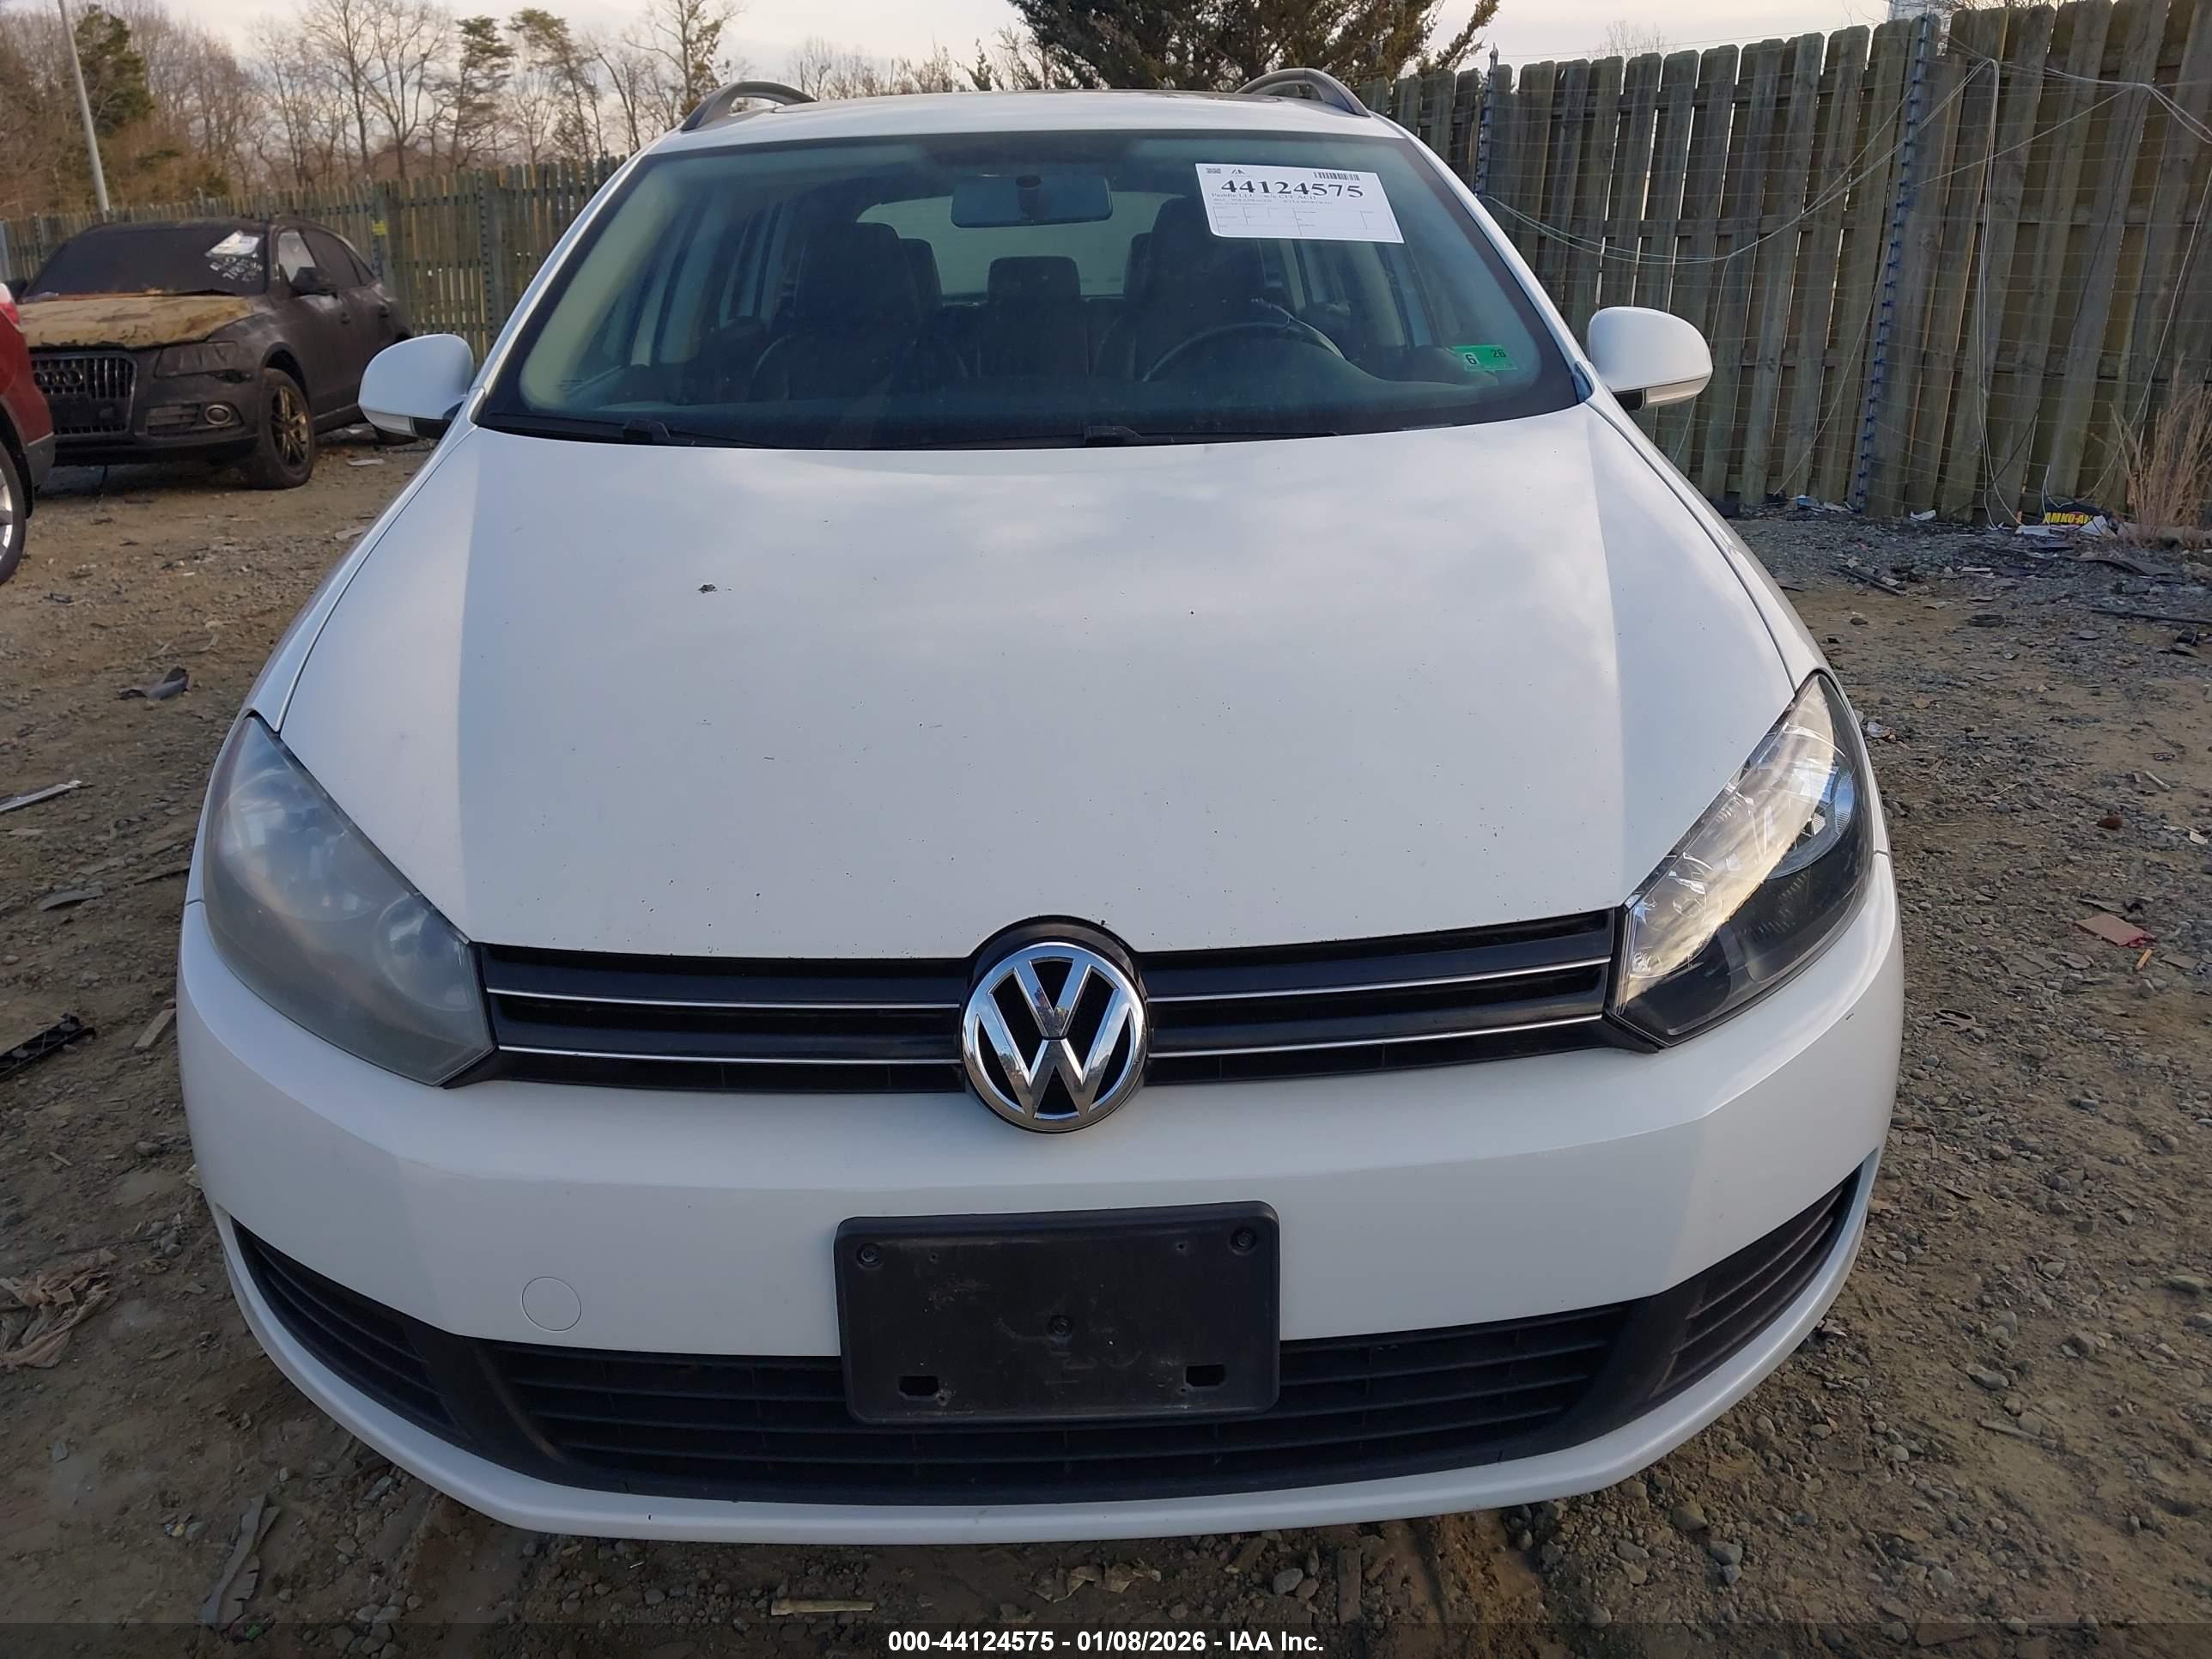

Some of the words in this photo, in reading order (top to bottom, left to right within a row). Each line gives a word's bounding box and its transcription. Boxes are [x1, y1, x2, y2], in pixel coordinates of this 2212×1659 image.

[1220, 179, 1364, 198] 44124575
[1465, 354, 1477, 365] 6
[1491, 349, 1506, 358] 26
